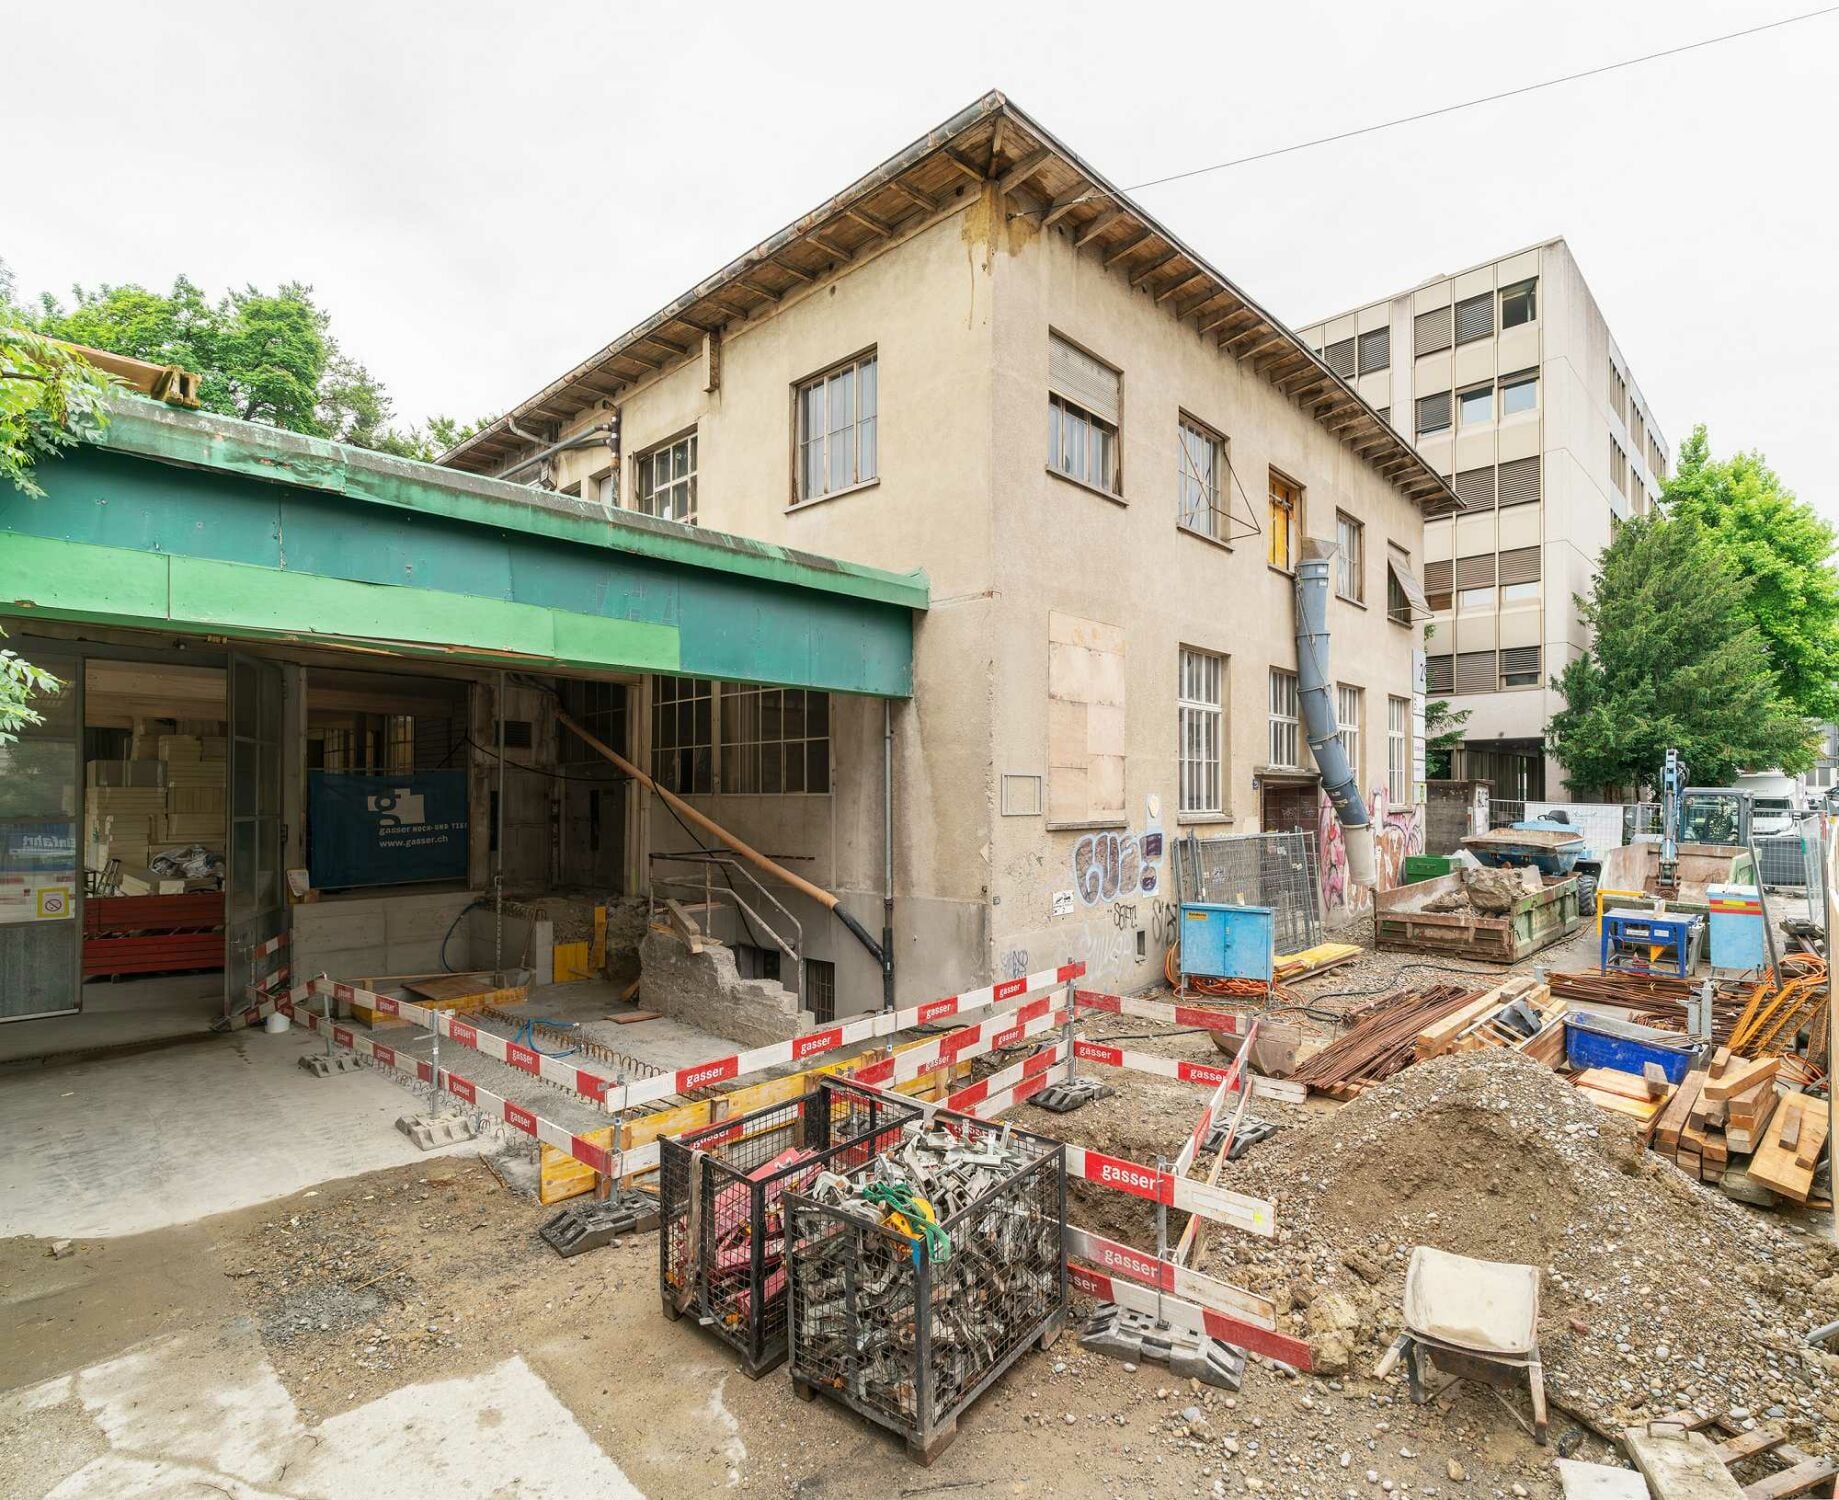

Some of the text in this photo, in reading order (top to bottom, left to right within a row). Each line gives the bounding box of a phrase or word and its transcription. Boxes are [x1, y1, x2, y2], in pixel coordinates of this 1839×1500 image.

[378, 826, 411, 836] gasser
[378, 835, 449, 848] www.gasser.ch
[999, 982, 1021, 998] gasser
[925, 1003, 952, 1020] gasser
[453, 1025, 472, 1040] gasser
[997, 1029, 1020, 1044] gasser
[801, 1035, 832, 1055] gasser
[1079, 1045, 1112, 1060] gasser
[511, 1049, 534, 1065] gasser
[925, 1055, 950, 1072] gasser
[686, 1066, 725, 1088] gasser
[452, 1081, 470, 1097] gasser
[510, 1111, 531, 1129] gasser
[1101, 1164, 1158, 1191] gasser
[1104, 1249, 1159, 1279] gasser
